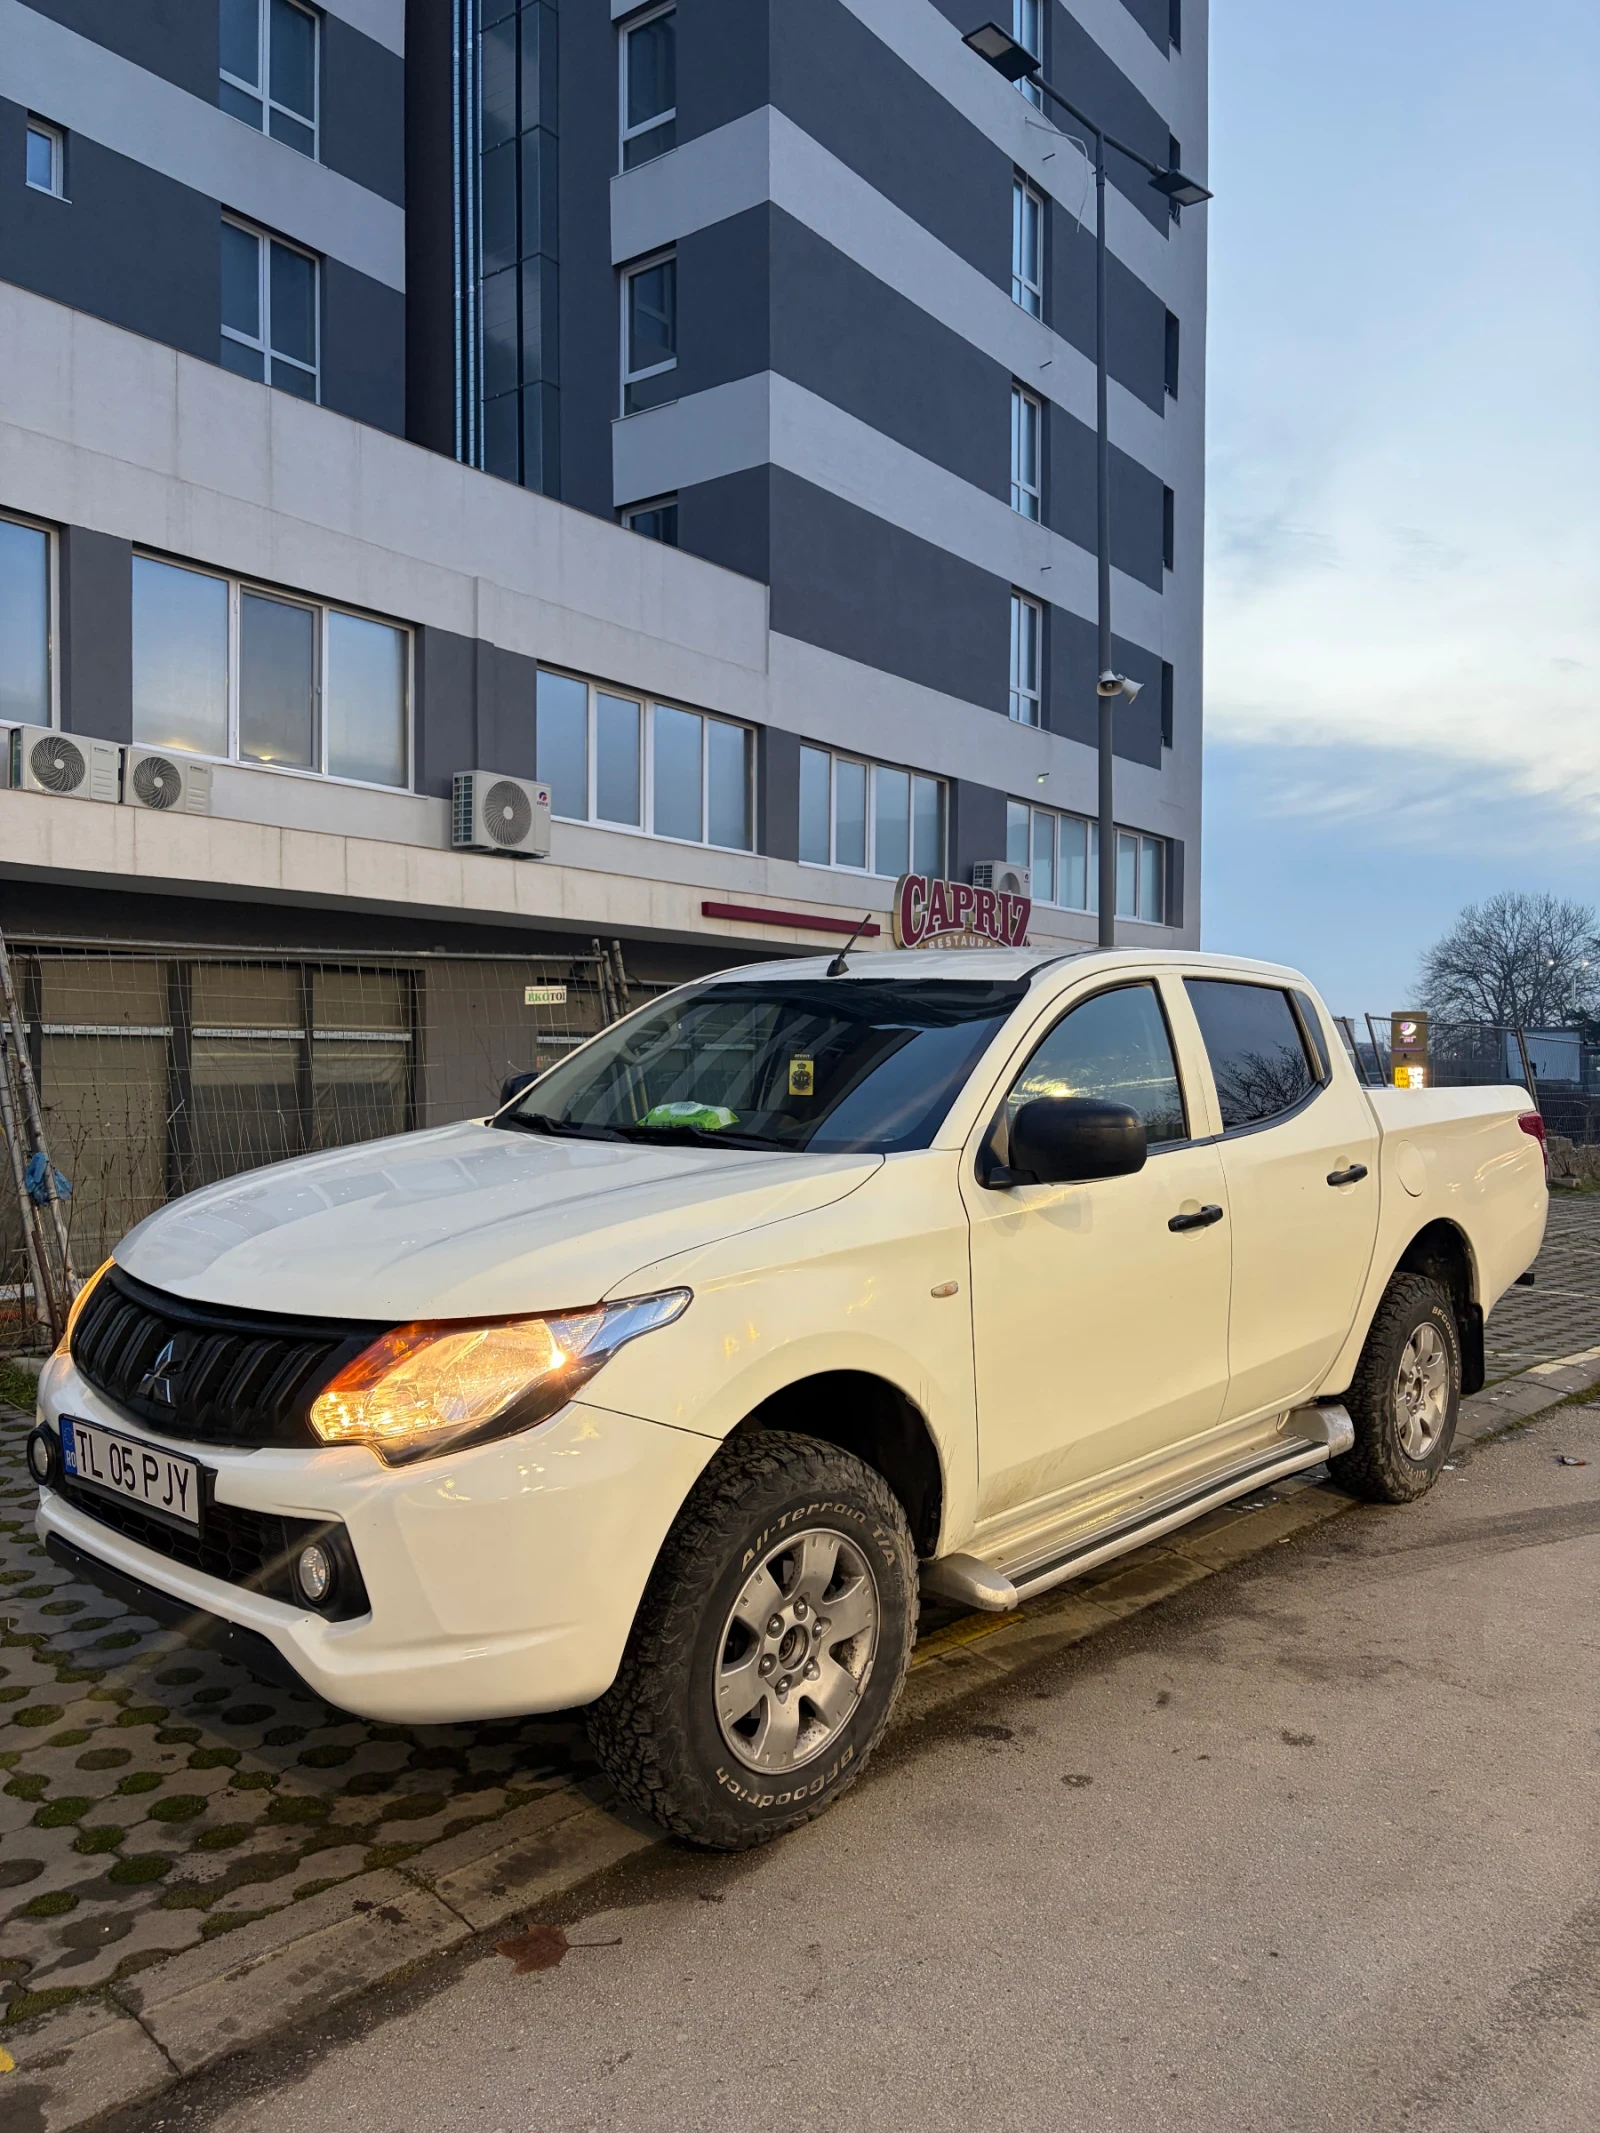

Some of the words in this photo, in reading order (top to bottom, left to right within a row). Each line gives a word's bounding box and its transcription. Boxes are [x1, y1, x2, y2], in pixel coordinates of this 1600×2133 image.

[65, 1449, 77, 1468] RO
[76, 1429, 104, 1480] TL
[109, 1442, 136, 1491] 05
[142, 1452, 189, 1513] PJY
[741, 1501, 867, 1572] All-Terrain
[715, 1743, 854, 1809] BFGoodrich
